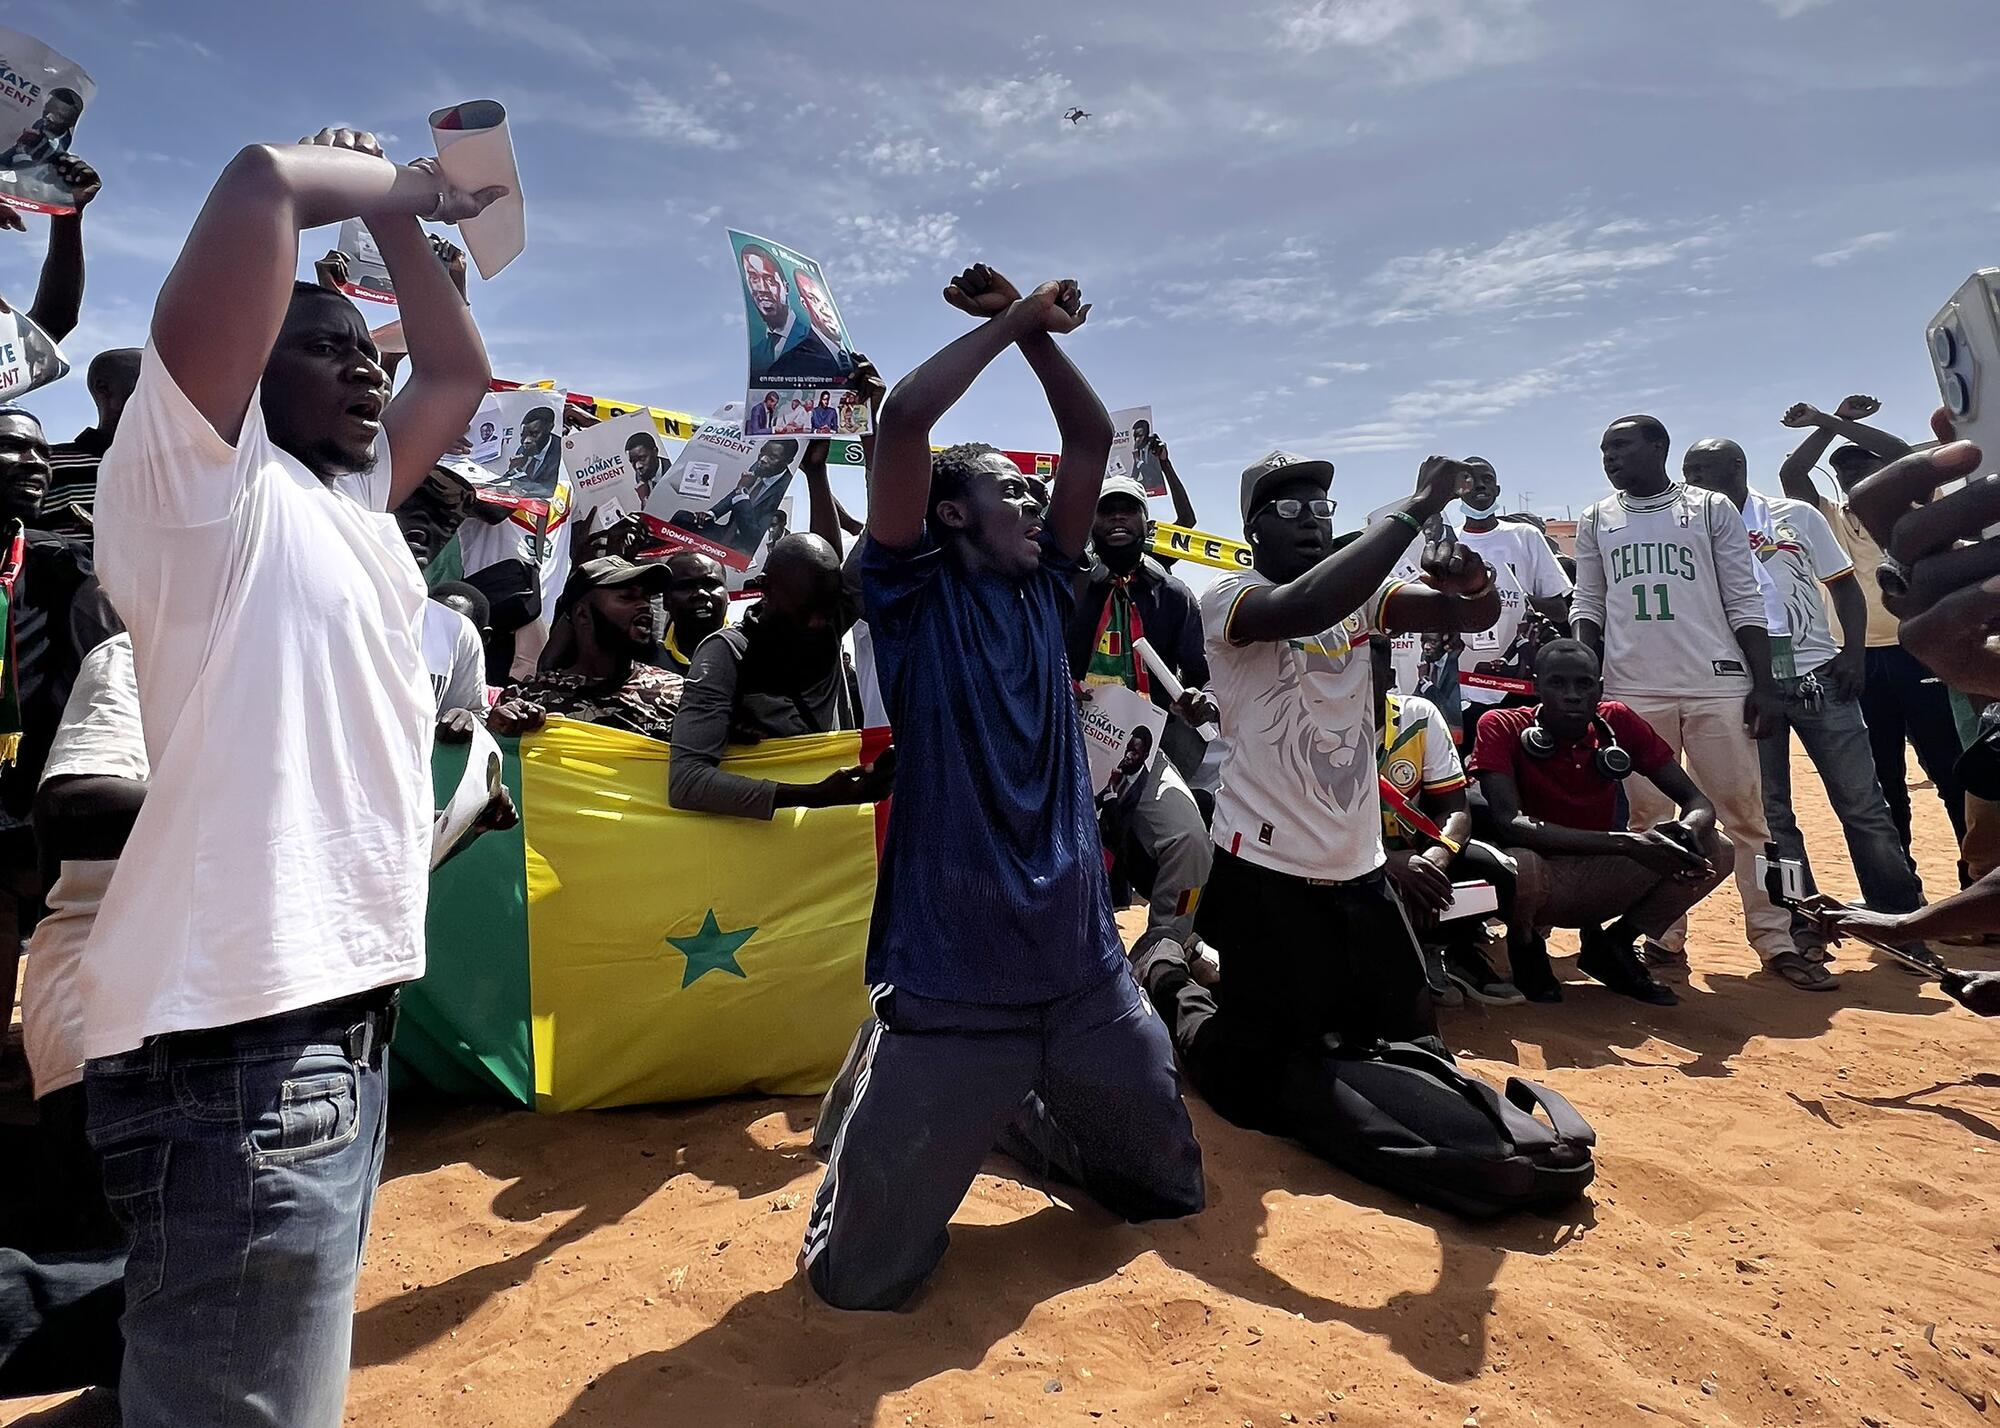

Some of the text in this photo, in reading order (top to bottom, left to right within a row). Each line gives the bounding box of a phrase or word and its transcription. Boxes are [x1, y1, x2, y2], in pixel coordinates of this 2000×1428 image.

[703, 425, 757, 446] DIOMAE
[575, 455, 623, 479] DIOMAYE
[661, 527, 727, 558] DIOMAYE SONKO
[1610, 542, 1696, 584] CELTICS
[1632, 584, 1675, 621] 11
